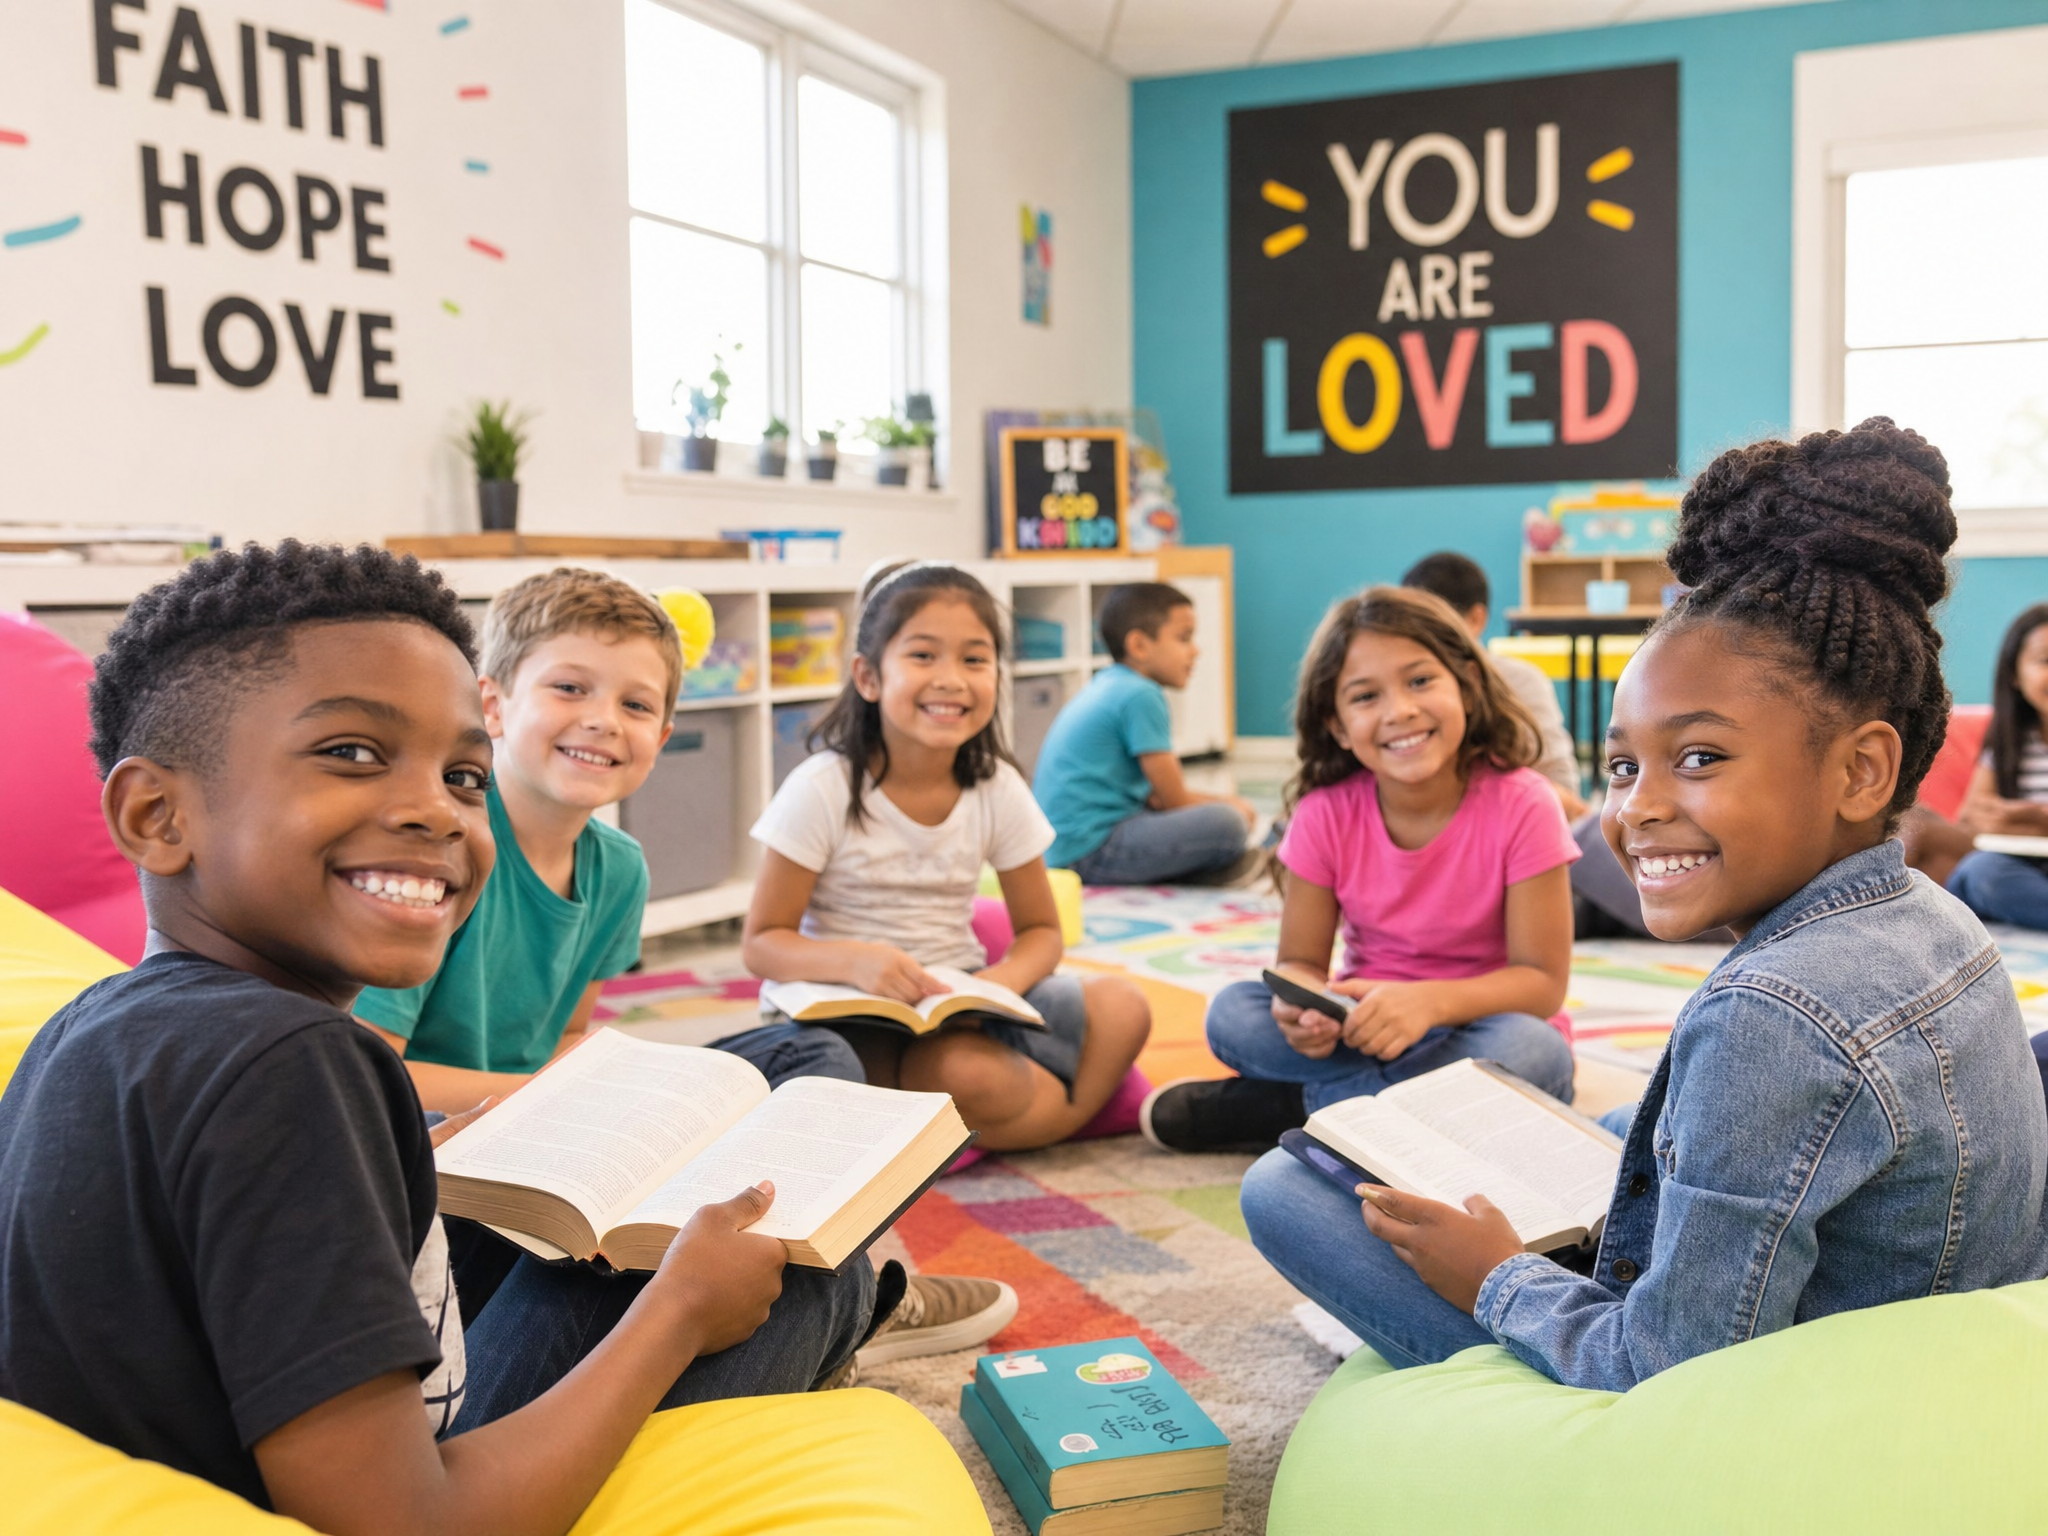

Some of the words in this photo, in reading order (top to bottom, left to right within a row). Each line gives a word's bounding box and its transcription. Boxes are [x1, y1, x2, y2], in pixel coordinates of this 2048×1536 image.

[91, 0, 386, 148] FAITH
[139, 143, 392, 274] HOPE
[1326, 122, 1561, 251] YOU
[145, 285, 402, 401] LOVE
[1377, 250, 1494, 324] ARE
[1262, 317, 1640, 458] LOVED
[1043, 437, 1091, 472] BE
